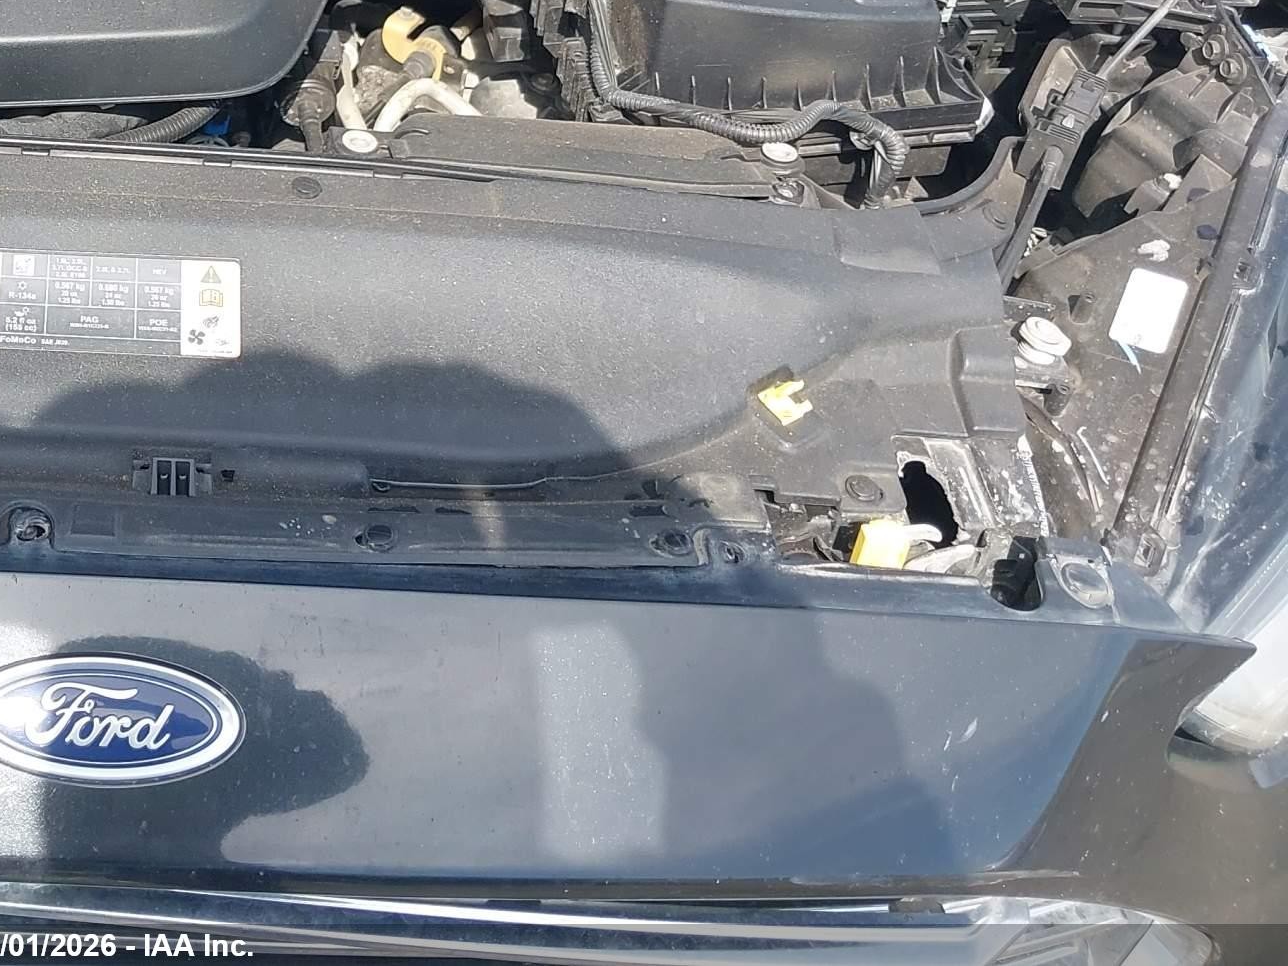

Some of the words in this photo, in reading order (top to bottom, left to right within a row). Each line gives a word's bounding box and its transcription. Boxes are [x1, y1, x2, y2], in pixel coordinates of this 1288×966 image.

[9, 292, 36, 300] R-134a
[80, 315, 99, 323] PAG
[0, 335, 37, 344] FoMoCo
[24, 681, 175, 750] Ford
